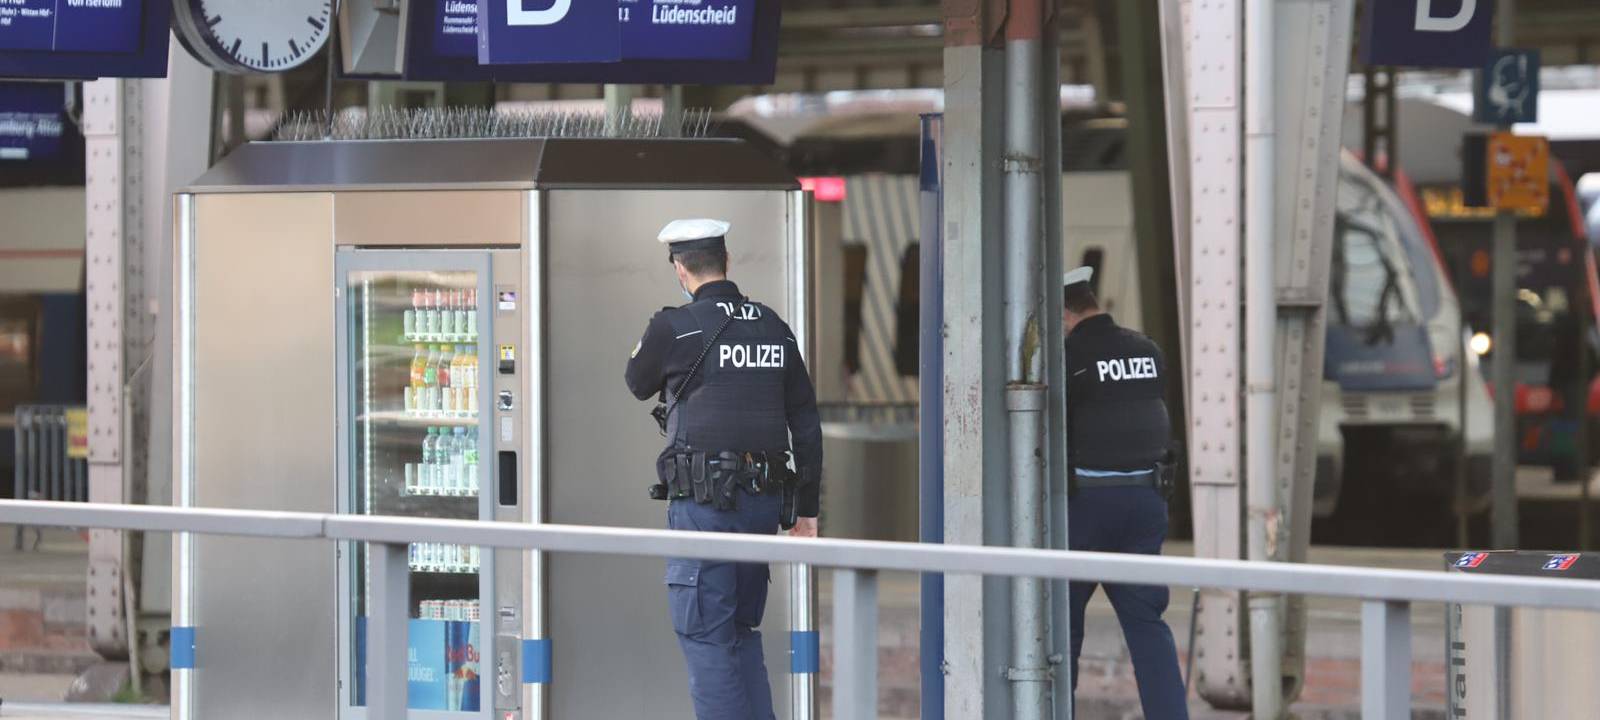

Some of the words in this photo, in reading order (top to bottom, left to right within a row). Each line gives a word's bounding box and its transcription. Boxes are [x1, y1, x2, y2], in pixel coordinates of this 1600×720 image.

[651, 4, 737, 24] Lüdenscheid
[719, 344, 784, 368] POLIZEI
[1096, 357, 1158, 382] POLIZEI
